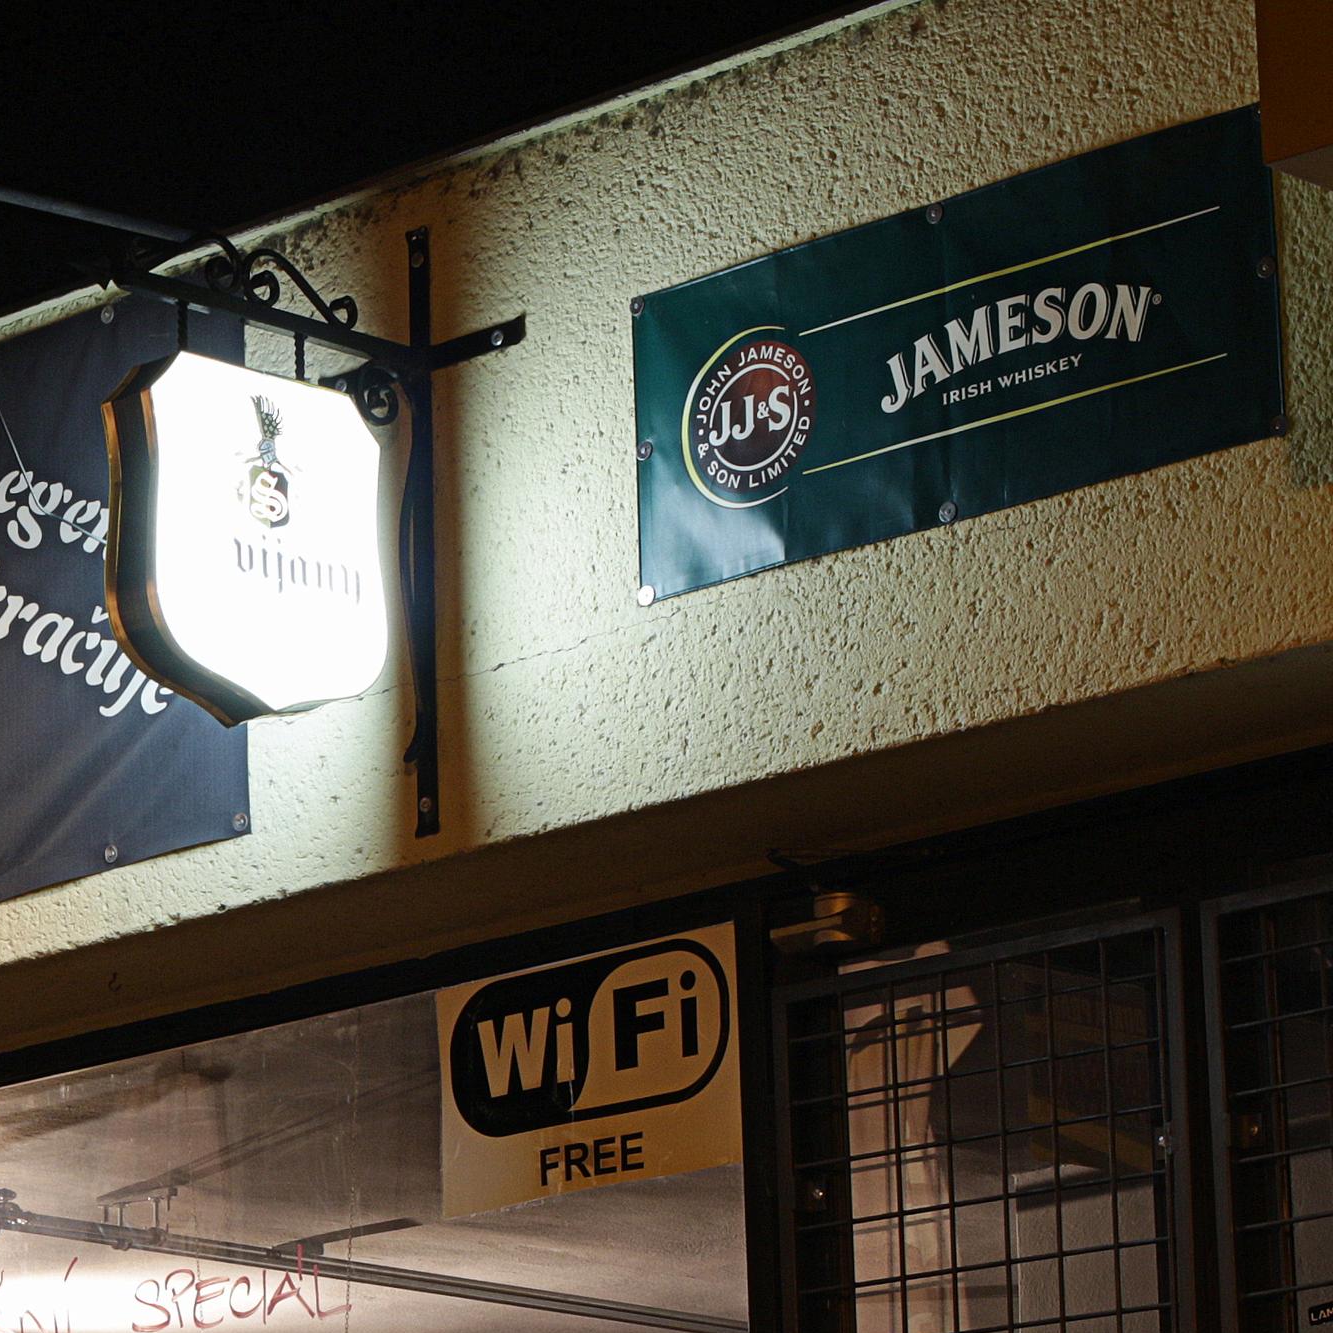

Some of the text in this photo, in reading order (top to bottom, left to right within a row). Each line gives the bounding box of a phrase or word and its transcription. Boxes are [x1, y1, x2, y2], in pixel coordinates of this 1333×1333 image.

[696, 346, 811, 426] JOHN JAMESON
[881, 283, 1152, 414] JAMESON
[942, 352, 1084, 406] IRISH WHISKEY
[706, 456, 741, 489] SON
[748, 415, 811, 490] LIMITED
[540, 1131, 645, 1187] FREE
